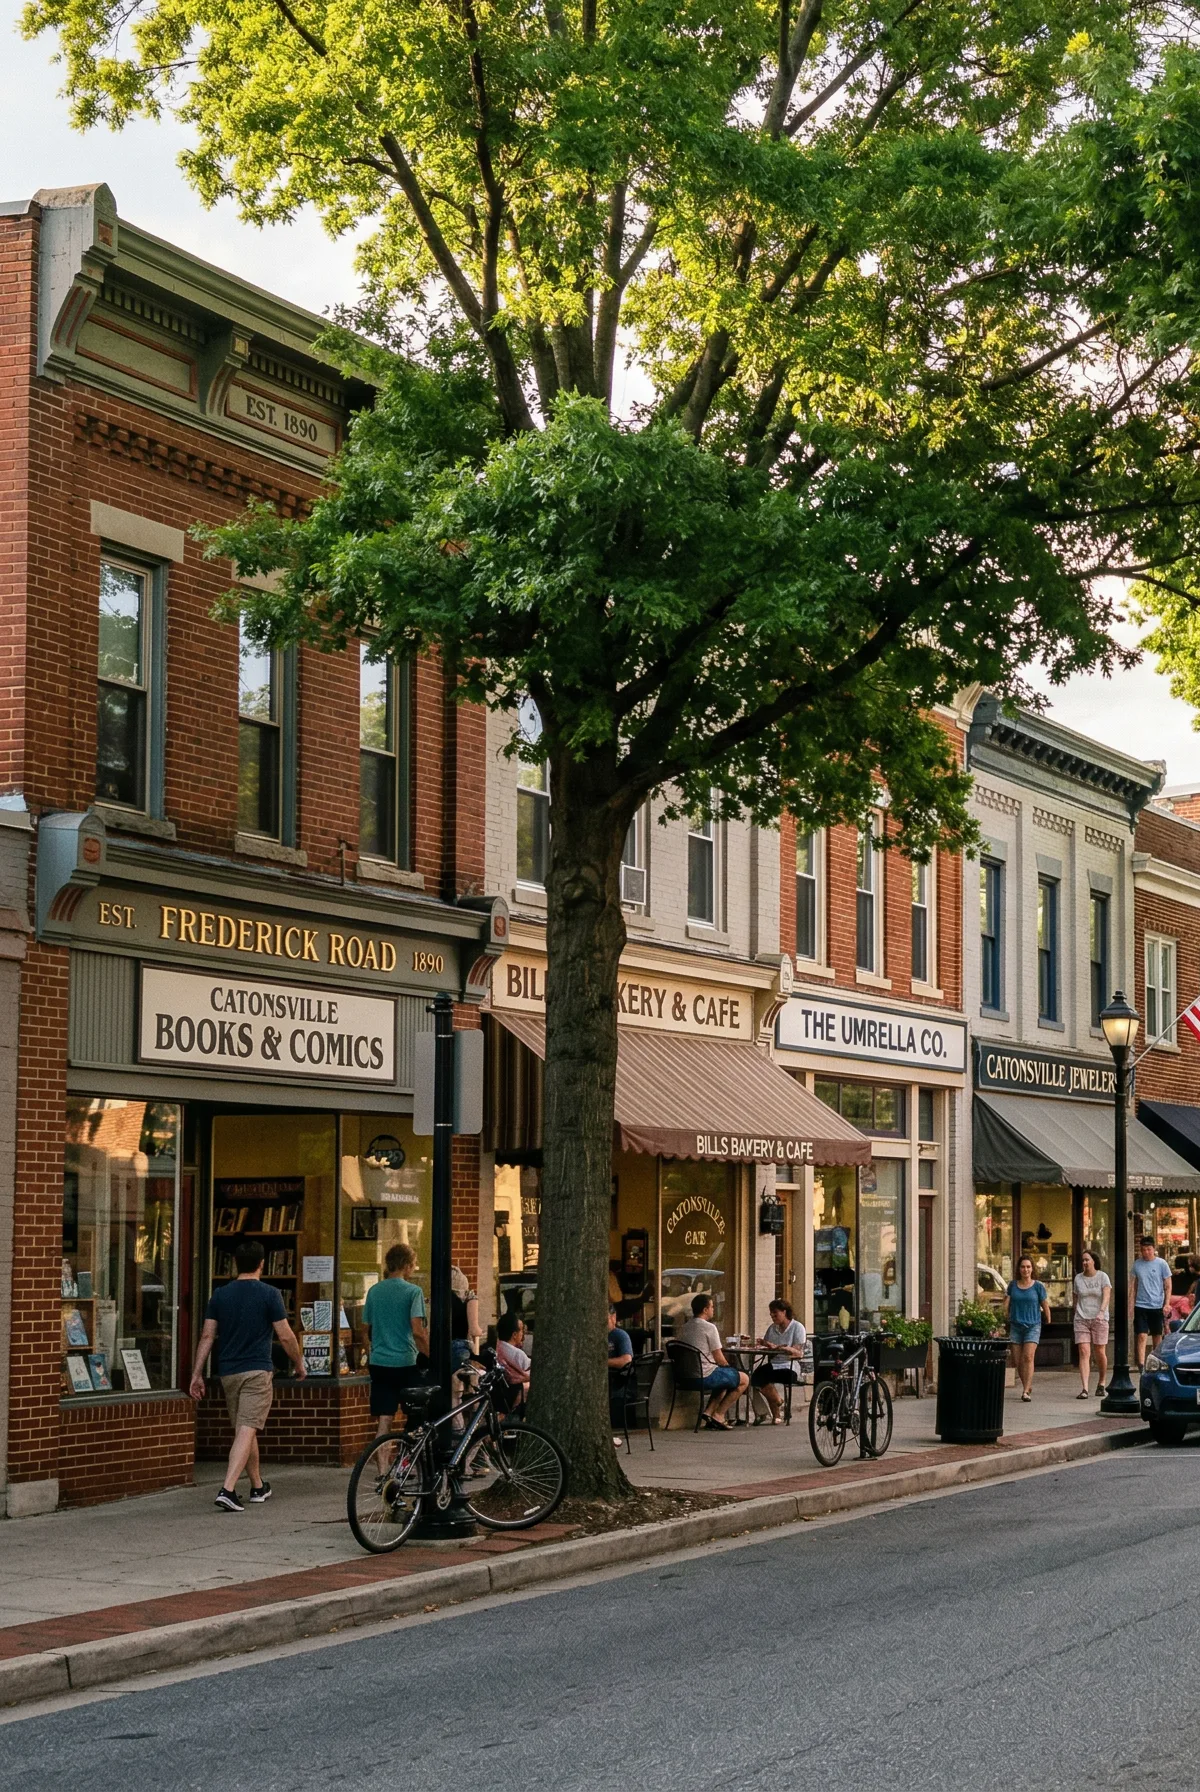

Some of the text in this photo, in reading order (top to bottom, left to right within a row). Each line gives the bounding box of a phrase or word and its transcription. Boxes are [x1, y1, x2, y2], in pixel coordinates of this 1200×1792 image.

[246, 394, 318, 443] EST. 1890
[99, 902, 444, 974] EST. FREDERICK ROAD 1890
[210, 986, 339, 1025] CATONSVILLE
[506, 963, 740, 1029] BIL KERY & CAFE
[155, 1013, 384, 1070] BOOKS & COMICS
[801, 1009, 947, 1058] THE UMRELLA CO.
[986, 1054, 1118, 1094] CATONSVILLE JEWELER
[696, 1135, 814, 1160] BILLS BAKERY & CAFE
